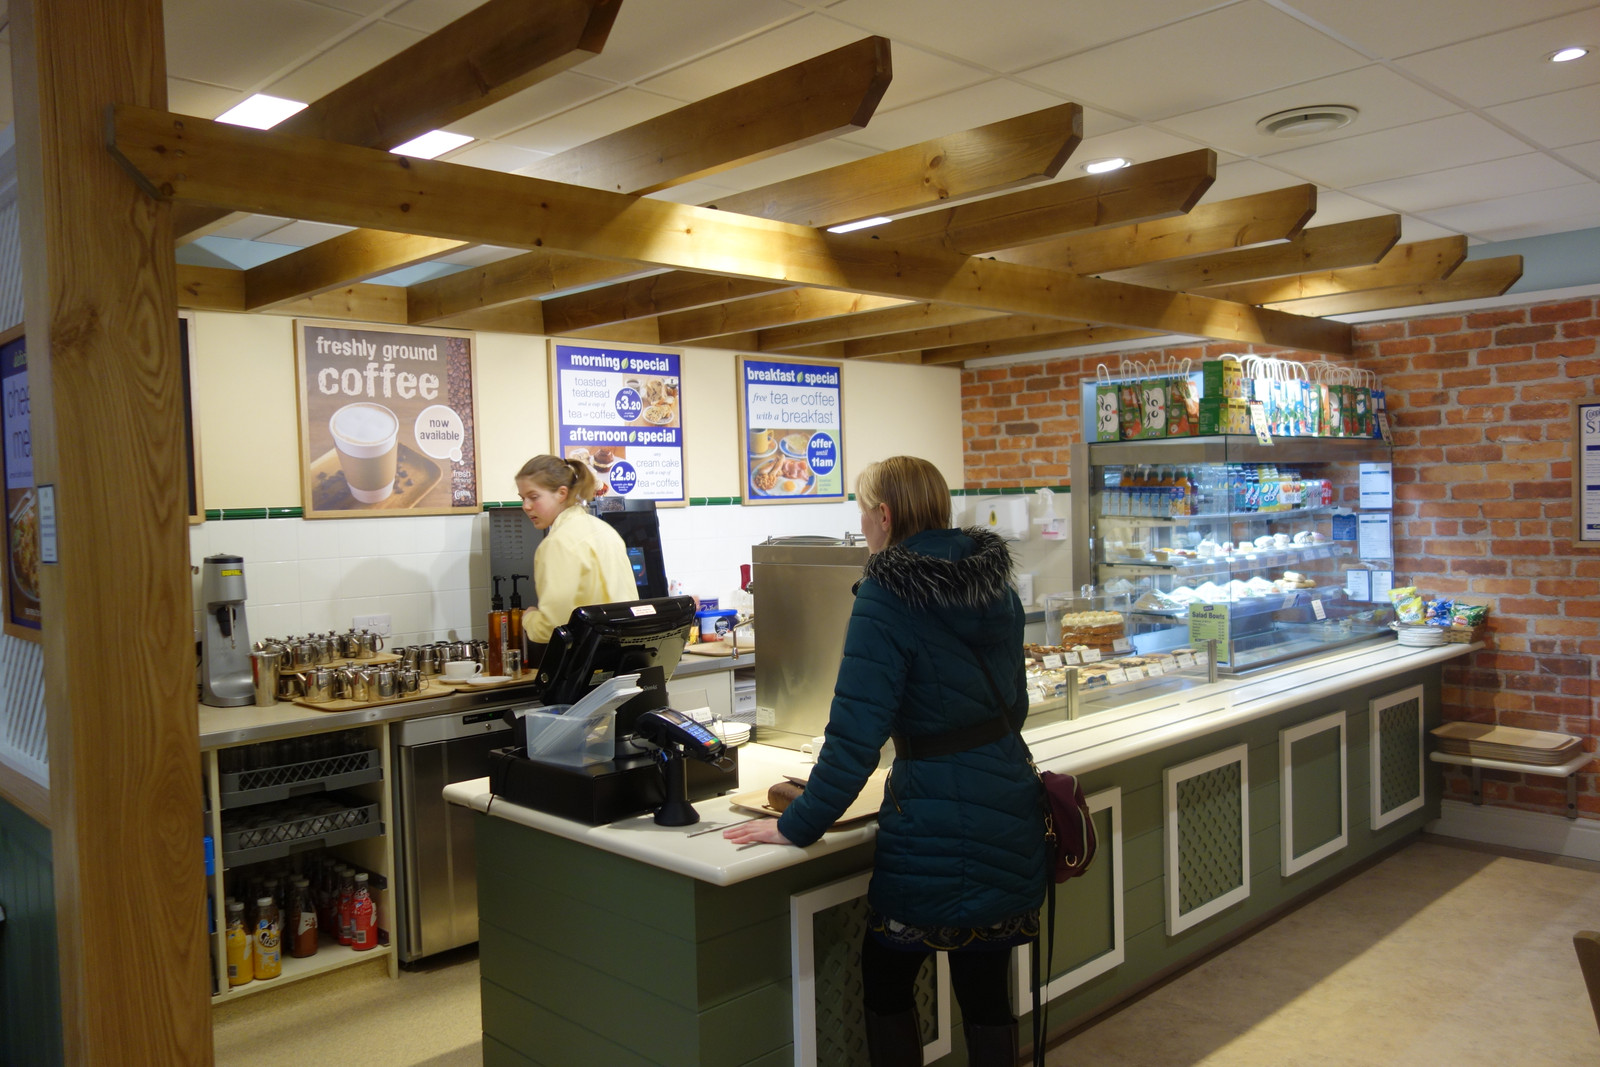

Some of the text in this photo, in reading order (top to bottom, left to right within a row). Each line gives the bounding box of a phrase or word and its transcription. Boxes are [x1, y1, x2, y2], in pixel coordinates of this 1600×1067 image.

[316, 336, 438, 362] freshly ground
[571, 354, 669, 372] morning special
[317, 362, 440, 400] coffee
[747, 367, 838, 386] breakfast special
[574, 377, 607, 388] toasted
[572, 388, 610, 398] teabread
[616, 395, 641, 411] £3.20
[752, 392, 768, 403] free
[770, 391, 789, 405] tea
[800, 391, 835, 407] coffee
[568, 409, 582, 418] tea
[590, 409, 616, 419] coffee
[756, 411, 773, 420] with
[781, 408, 834, 424] breakfast
[429, 419, 449, 428] now
[420, 430, 460, 441] available
[569, 427, 676, 444] afternoon special
[811, 438, 833, 448] offer
[636, 458, 680, 468] cream cake
[811, 458, 833, 467] 11am
[610, 466, 636, 481] £2.80
[637, 479, 650, 488] tea
[656, 478, 680, 488] coffee
[1192, 611, 1225, 620] Salad Bowls
